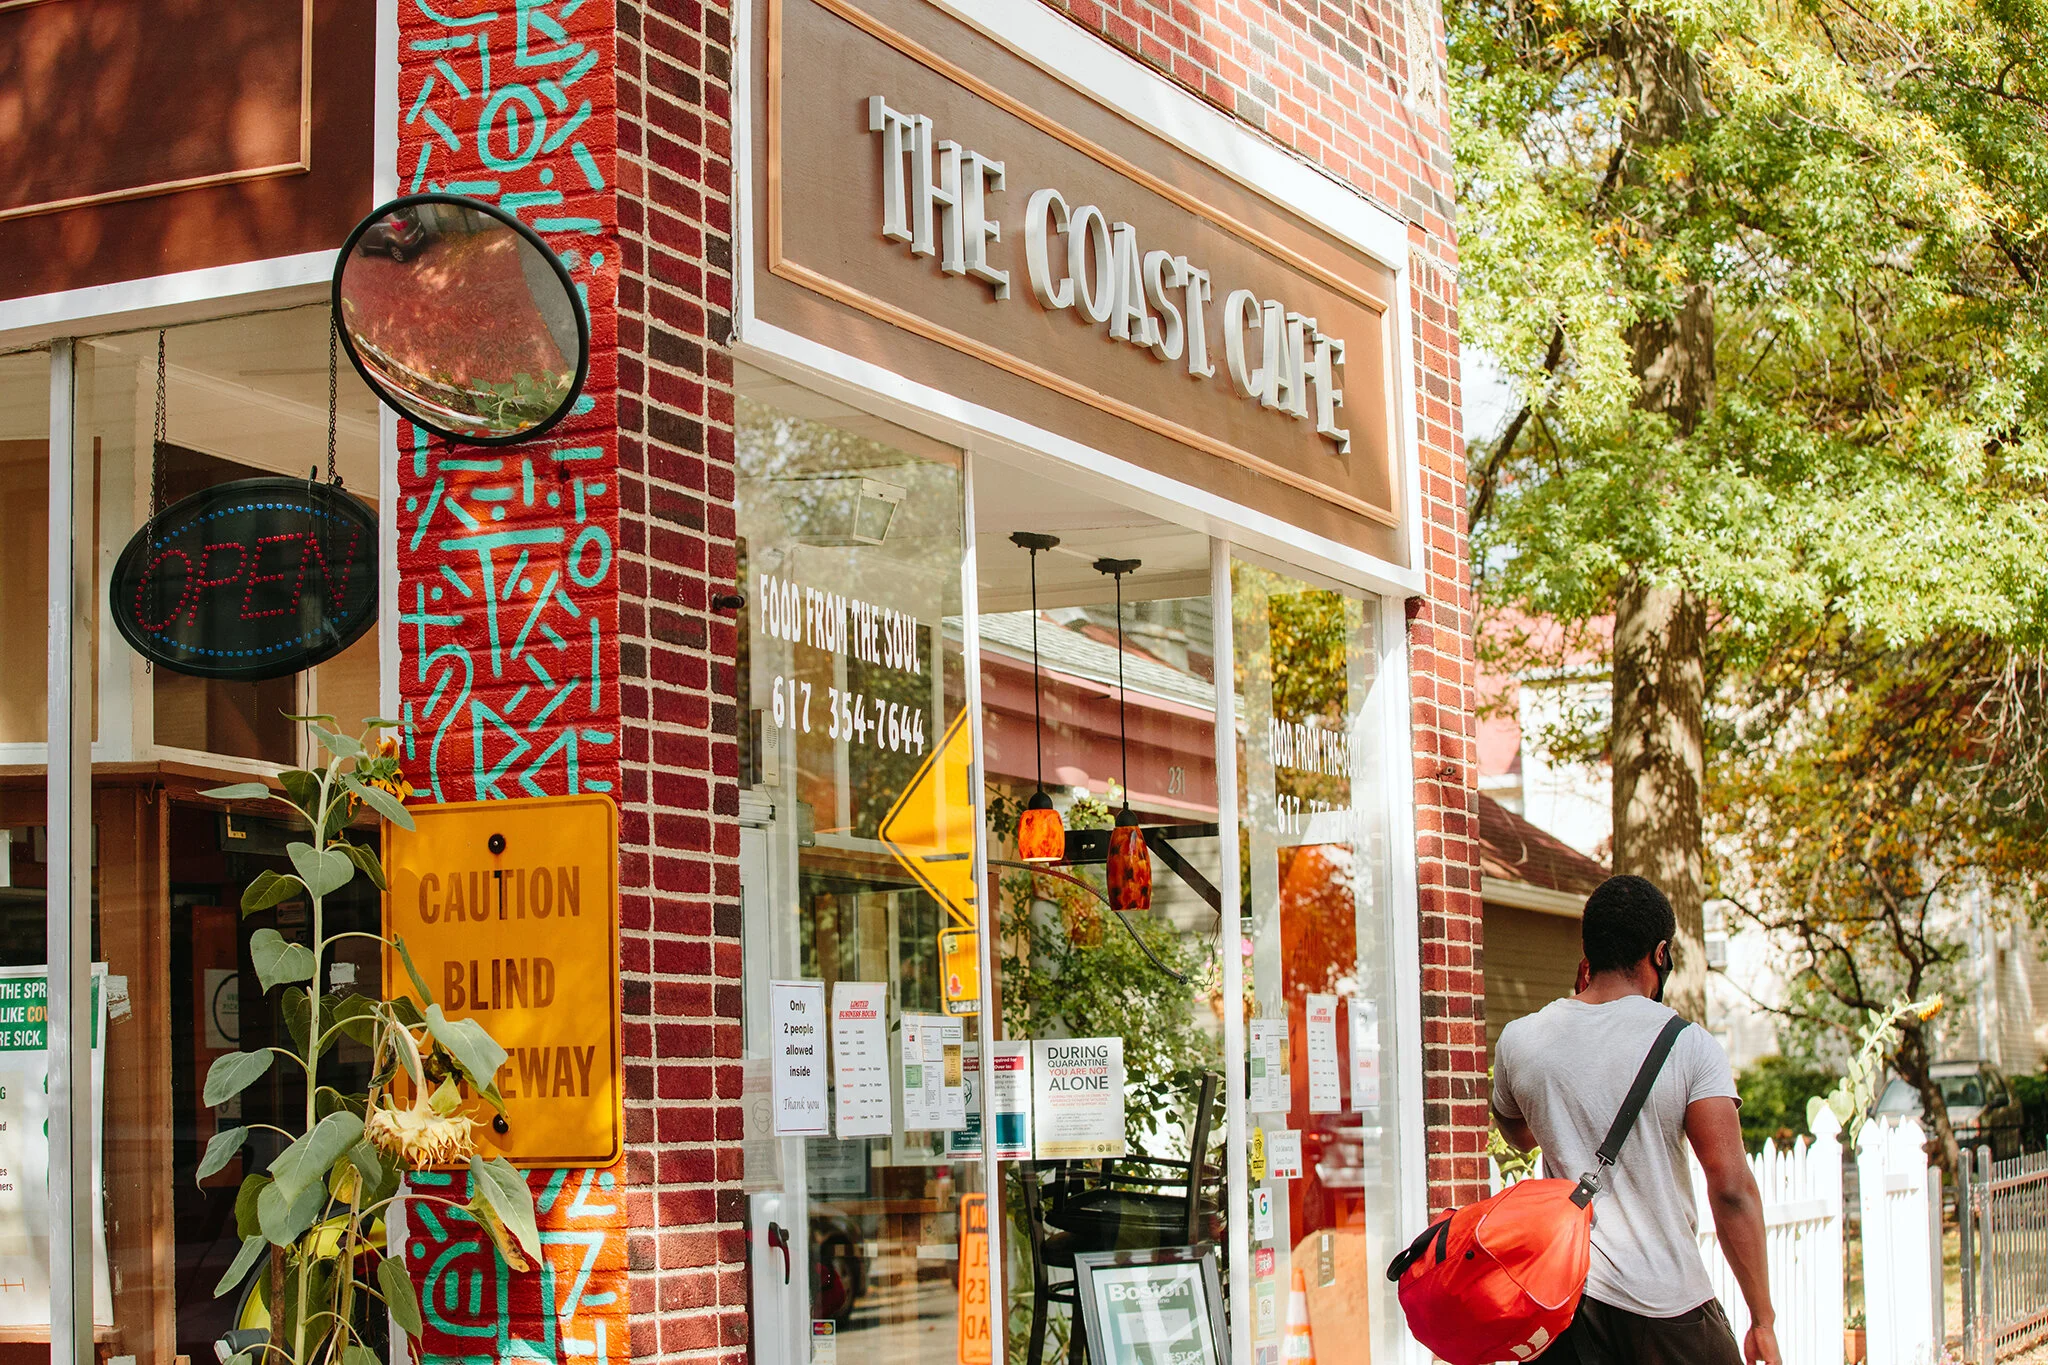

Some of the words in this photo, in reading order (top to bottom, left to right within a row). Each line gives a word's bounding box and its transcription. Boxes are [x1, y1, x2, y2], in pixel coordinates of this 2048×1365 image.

[869, 95, 1010, 301] THE
[1025, 187, 1215, 379] COAST
[1223, 289, 1351, 455] CAFE
[134, 523, 361, 632] OPEN
[760, 574, 801, 642] FOOD
[806, 586, 848, 656] FROM
[851, 599, 881, 666] THE
[884, 607, 921, 676] SOUL
[772, 675, 812, 733] 617
[828, 686, 925, 757] 354-7644
[1268, 717, 1293, 768] FOOD
[1295, 723, 1320, 773] FROM
[1322, 729, 1340, 778] THE
[1277, 793, 1301, 835] 617
[418, 866, 580, 924] CAUTION
[23, 982, 48, 999] SPR
[443, 957, 556, 1011] BLIND
[0, 1006, 25, 1023] LIKE
[789, 1000, 806, 1014] Only
[784, 1023, 789, 1034] 2
[790, 1023, 814, 1036] people
[786, 1045, 813, 1055] allowed
[1047, 1045, 1108, 1059] DURING
[789, 1066, 811, 1077] inside
[1049, 1068, 1068, 1076] YOU
[1070, 1067, 1087, 1075] ARE
[1089, 1067, 1108, 1075] NOT
[1049, 1076, 1109, 1091] ALONE
[783, 1096, 805, 1110] Thank
[807, 1100, 819, 1114] you
[1108, 1281, 1189, 1302] Boston
